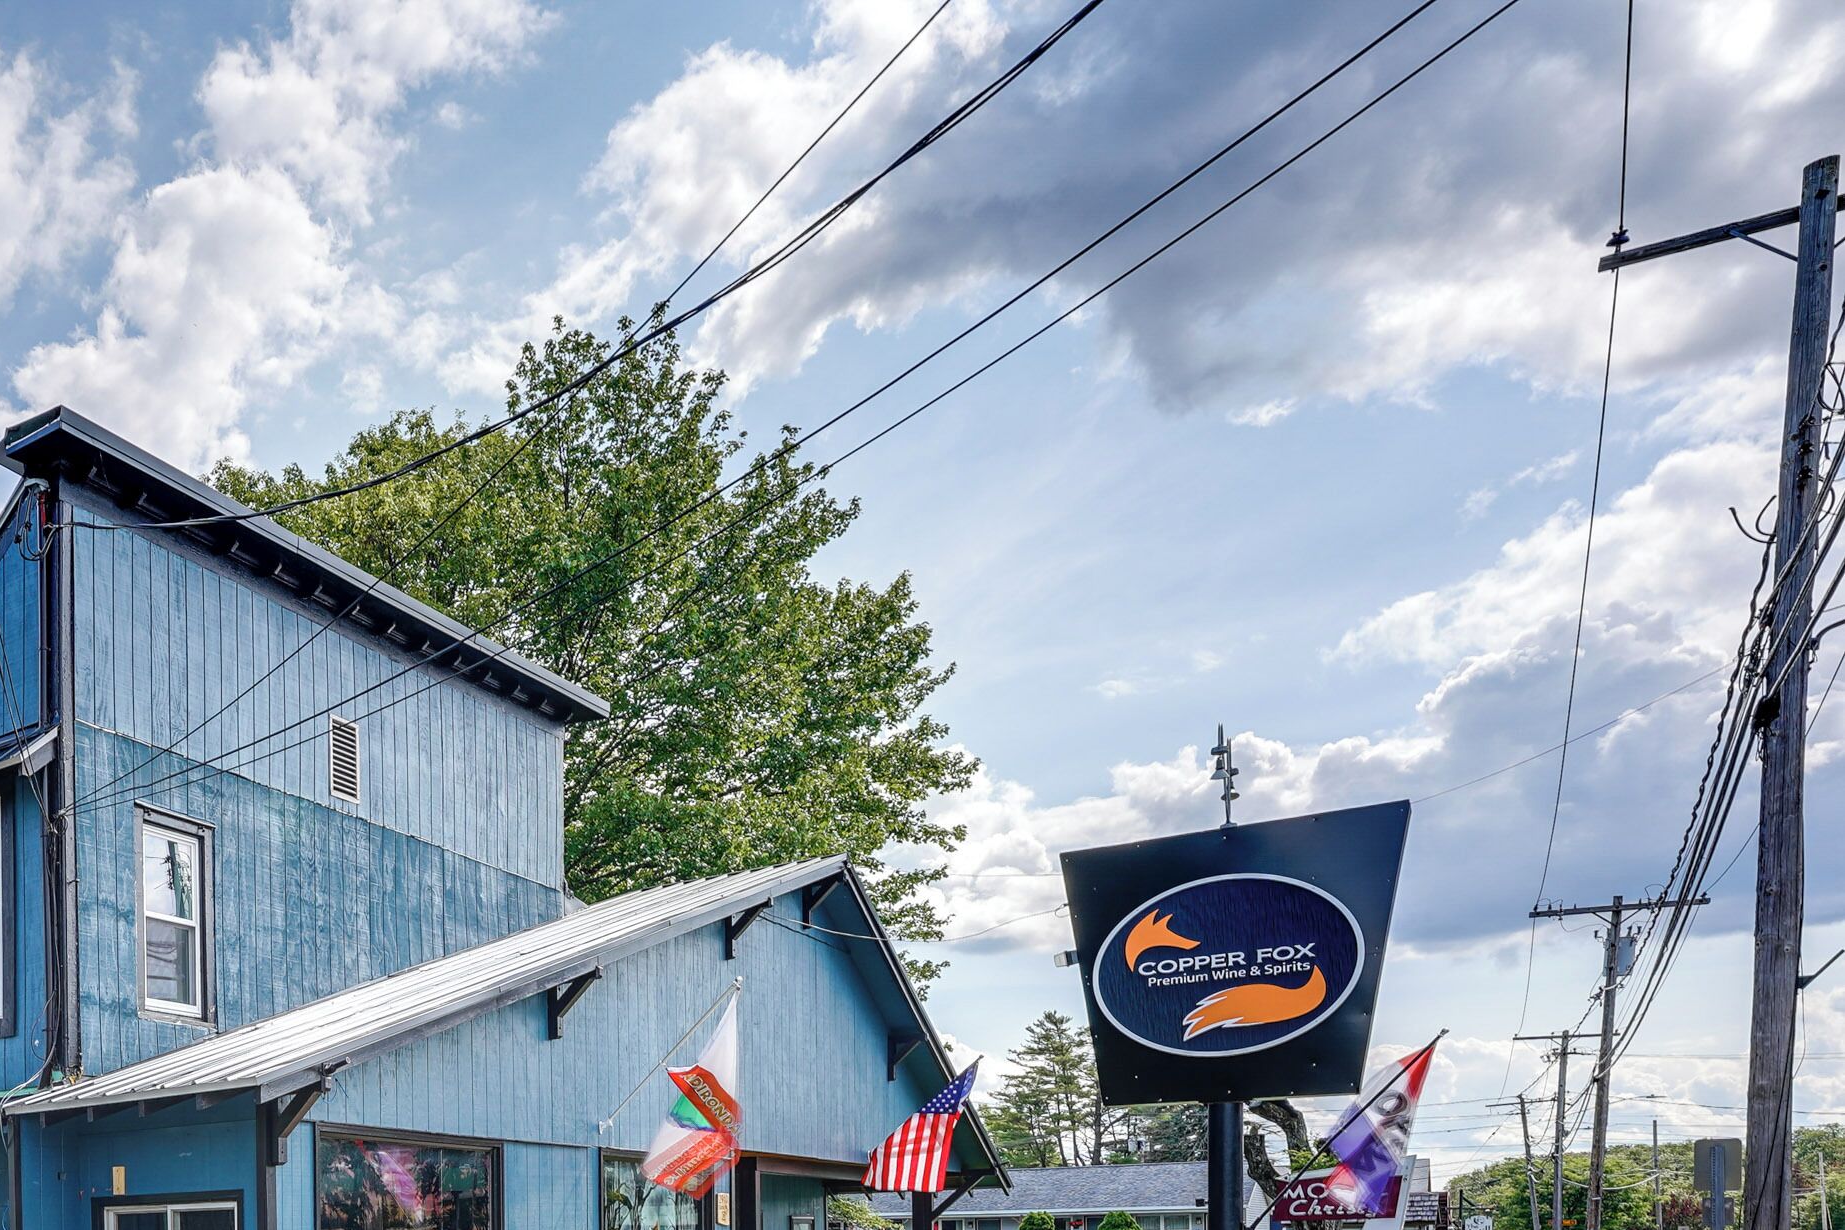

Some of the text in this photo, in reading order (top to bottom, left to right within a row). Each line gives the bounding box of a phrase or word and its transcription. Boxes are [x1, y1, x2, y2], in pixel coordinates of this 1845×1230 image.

[1138, 943, 1316, 976] COPPER FOX
[1148, 961, 1311, 987] Premium Wine & Spirits
